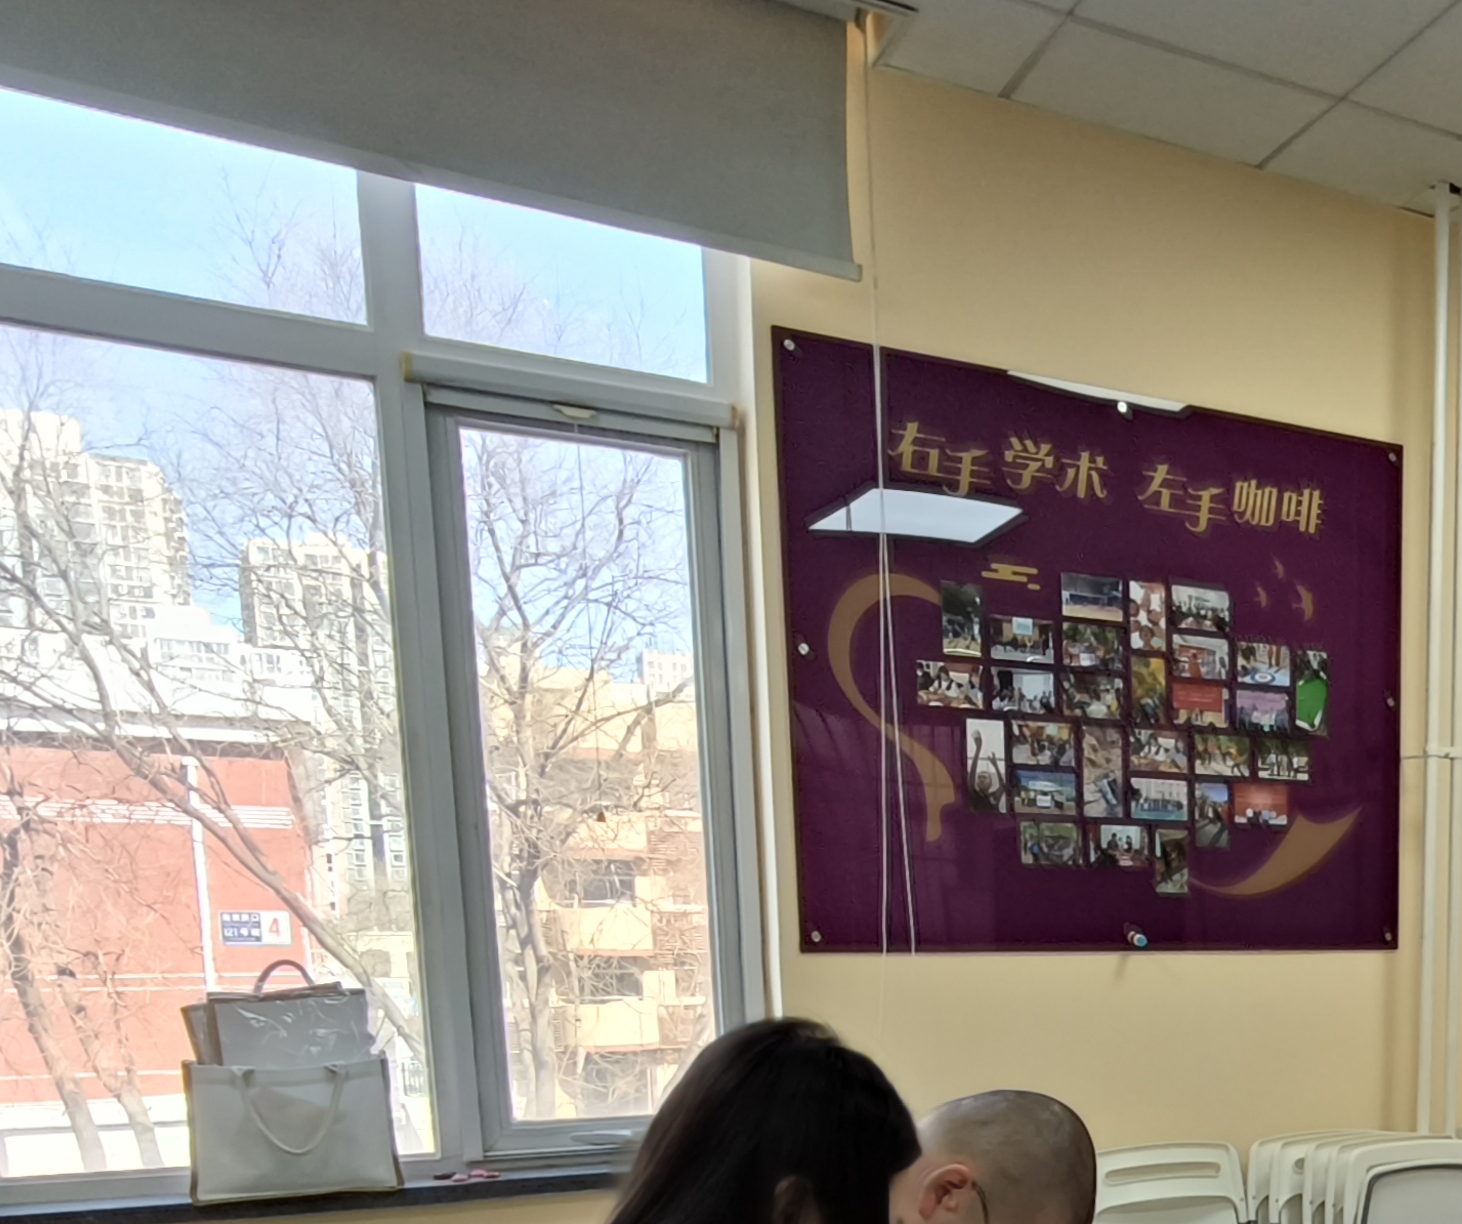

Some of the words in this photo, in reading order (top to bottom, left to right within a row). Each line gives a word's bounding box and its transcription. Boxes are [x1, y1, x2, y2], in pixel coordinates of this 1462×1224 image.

[888, 422, 1108, 499] 右手学术
[1138, 464, 1324, 534] 左手咖啡
